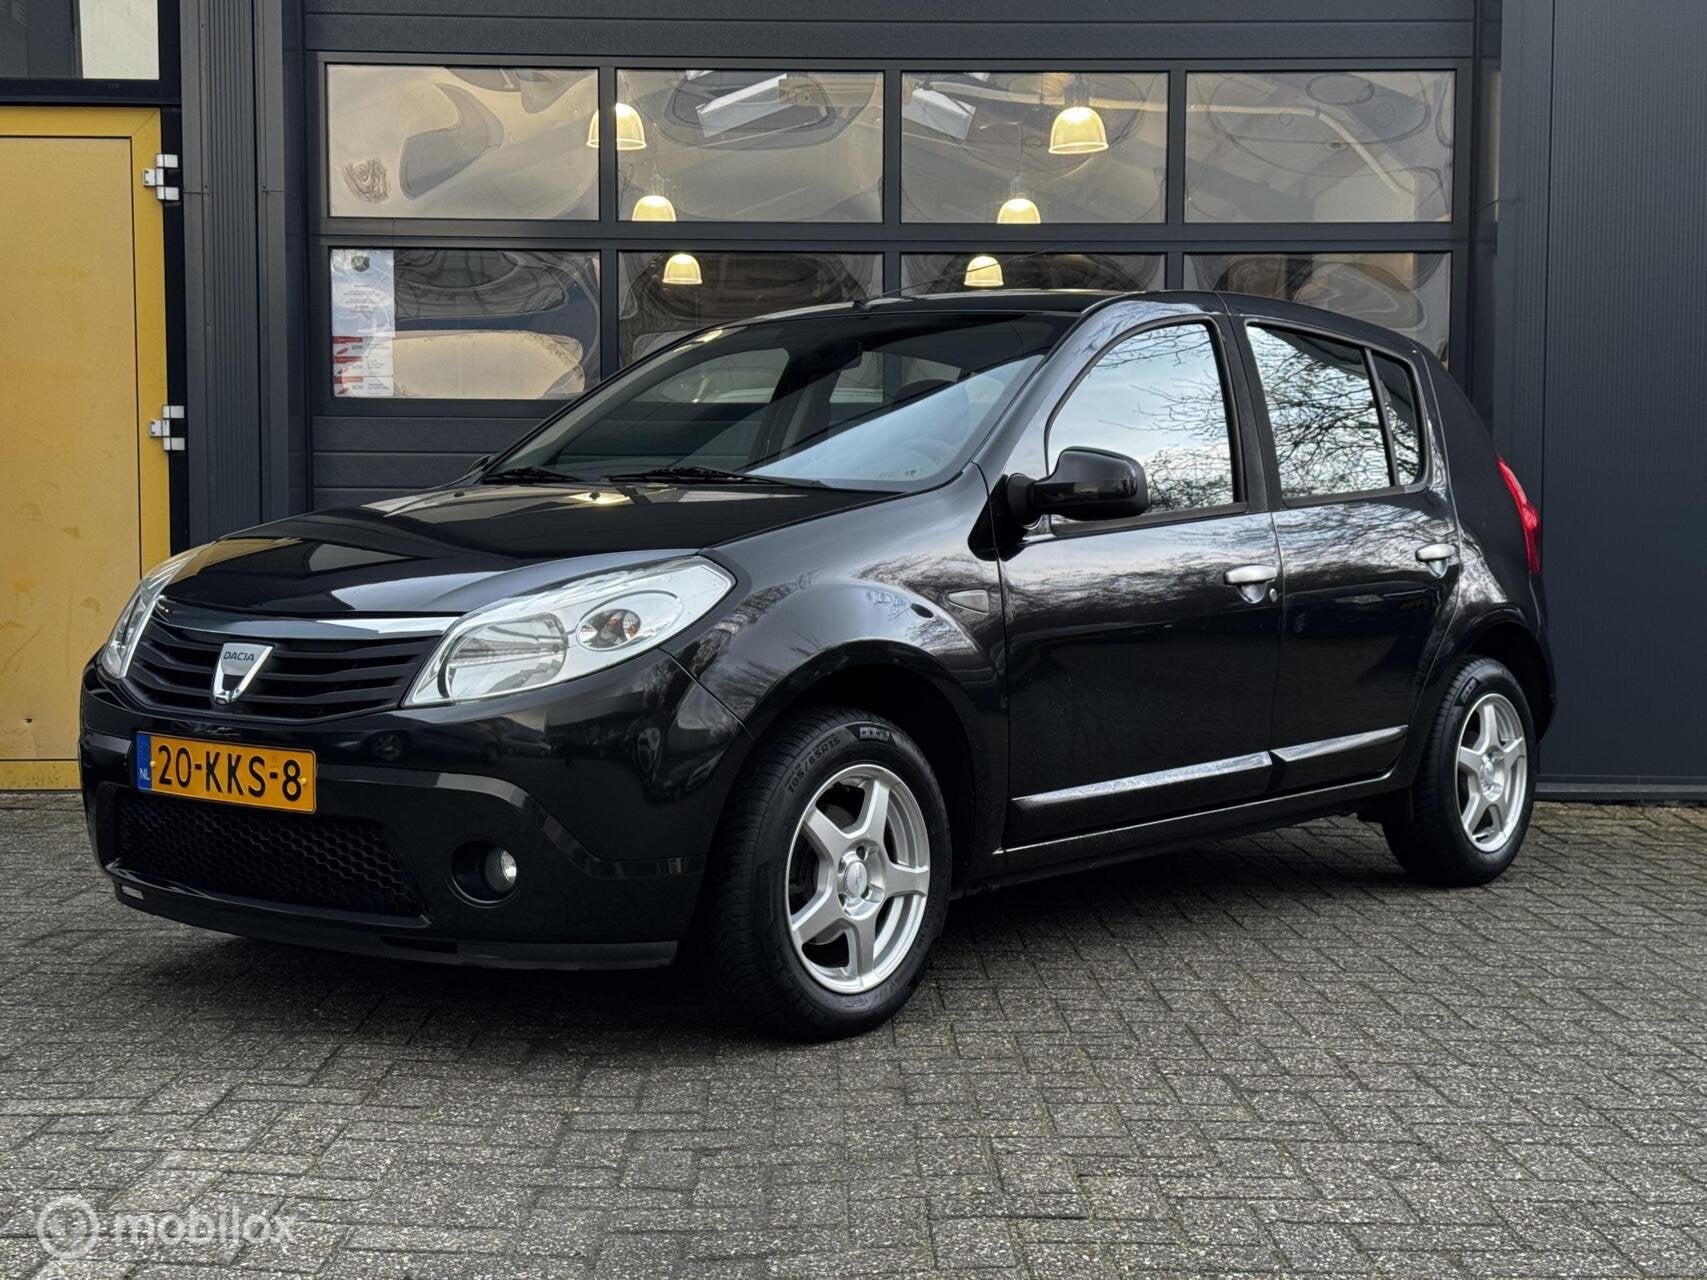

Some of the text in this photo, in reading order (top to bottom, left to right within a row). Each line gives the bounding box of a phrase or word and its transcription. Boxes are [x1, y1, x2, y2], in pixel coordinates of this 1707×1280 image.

[223, 651, 255, 662] DACIA
[139, 767, 150, 781] NL
[158, 744, 302, 802] 20-KKS-8
